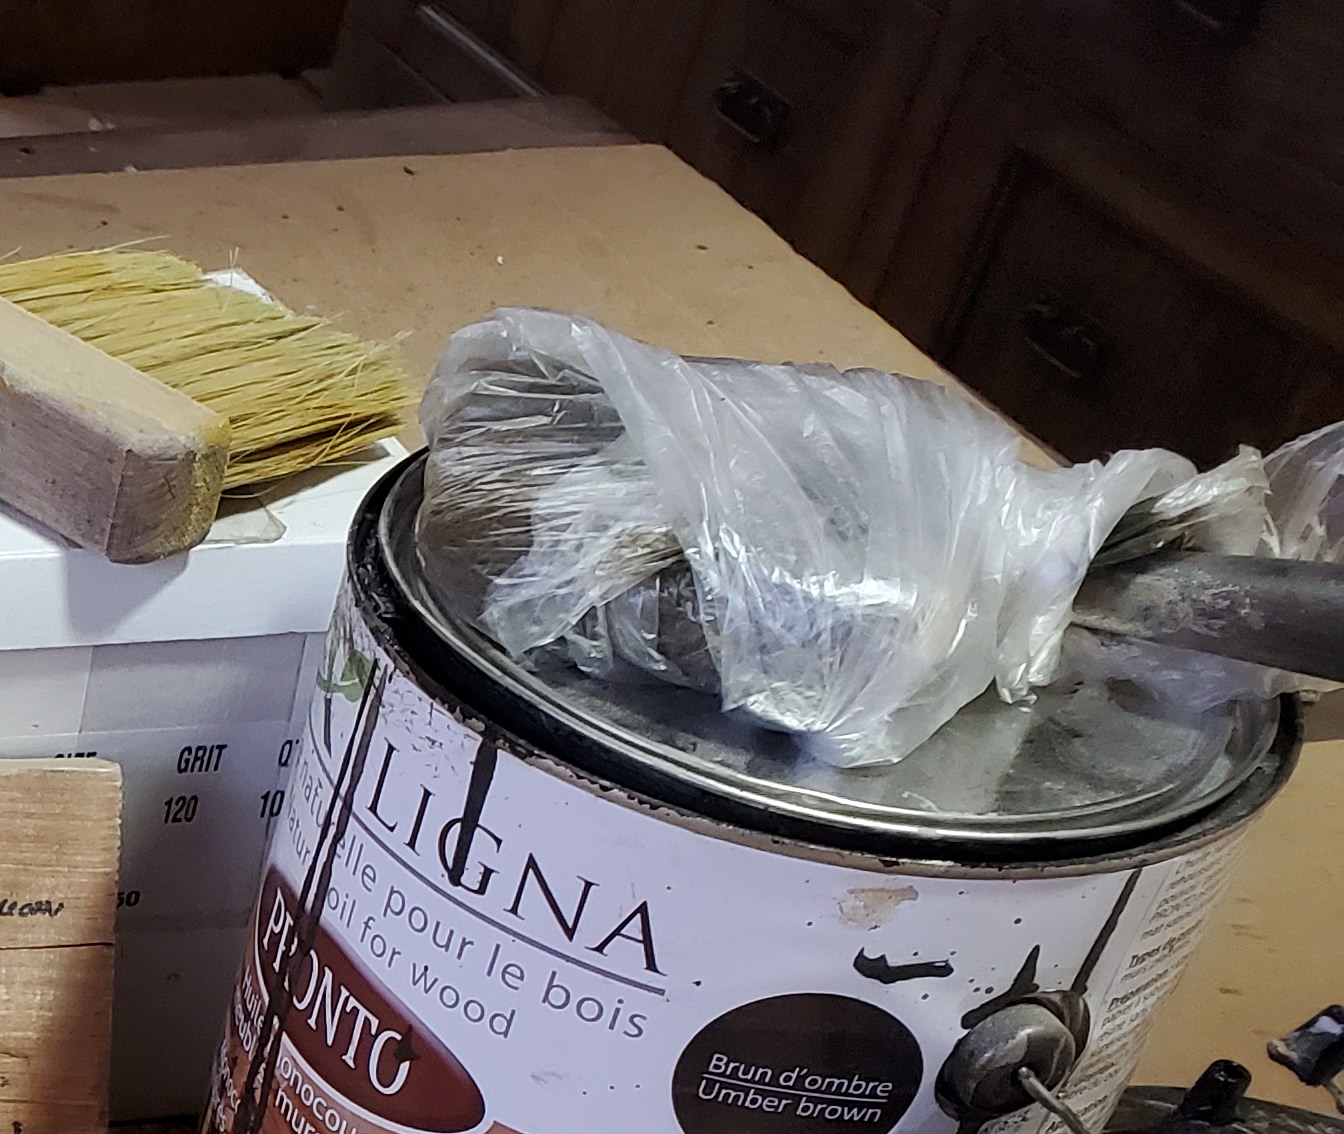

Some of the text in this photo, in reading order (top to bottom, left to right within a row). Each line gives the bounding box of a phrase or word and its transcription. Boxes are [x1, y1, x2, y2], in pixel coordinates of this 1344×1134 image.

[177, 744, 228, 774] GRIT
[164, 795, 199, 824] 120
[365, 737, 668, 976] LIGNA
[327, 886, 358, 929] oil
[360, 916, 402, 968] for
[411, 962, 517, 1039] wood
[384, 886, 474, 962] pour
[485, 943, 525, 991] le
[542, 971, 648, 1039] bois
[708, 1053, 893, 1097] Brun d'ombre
[698, 1079, 882, 1123] Umber brown
